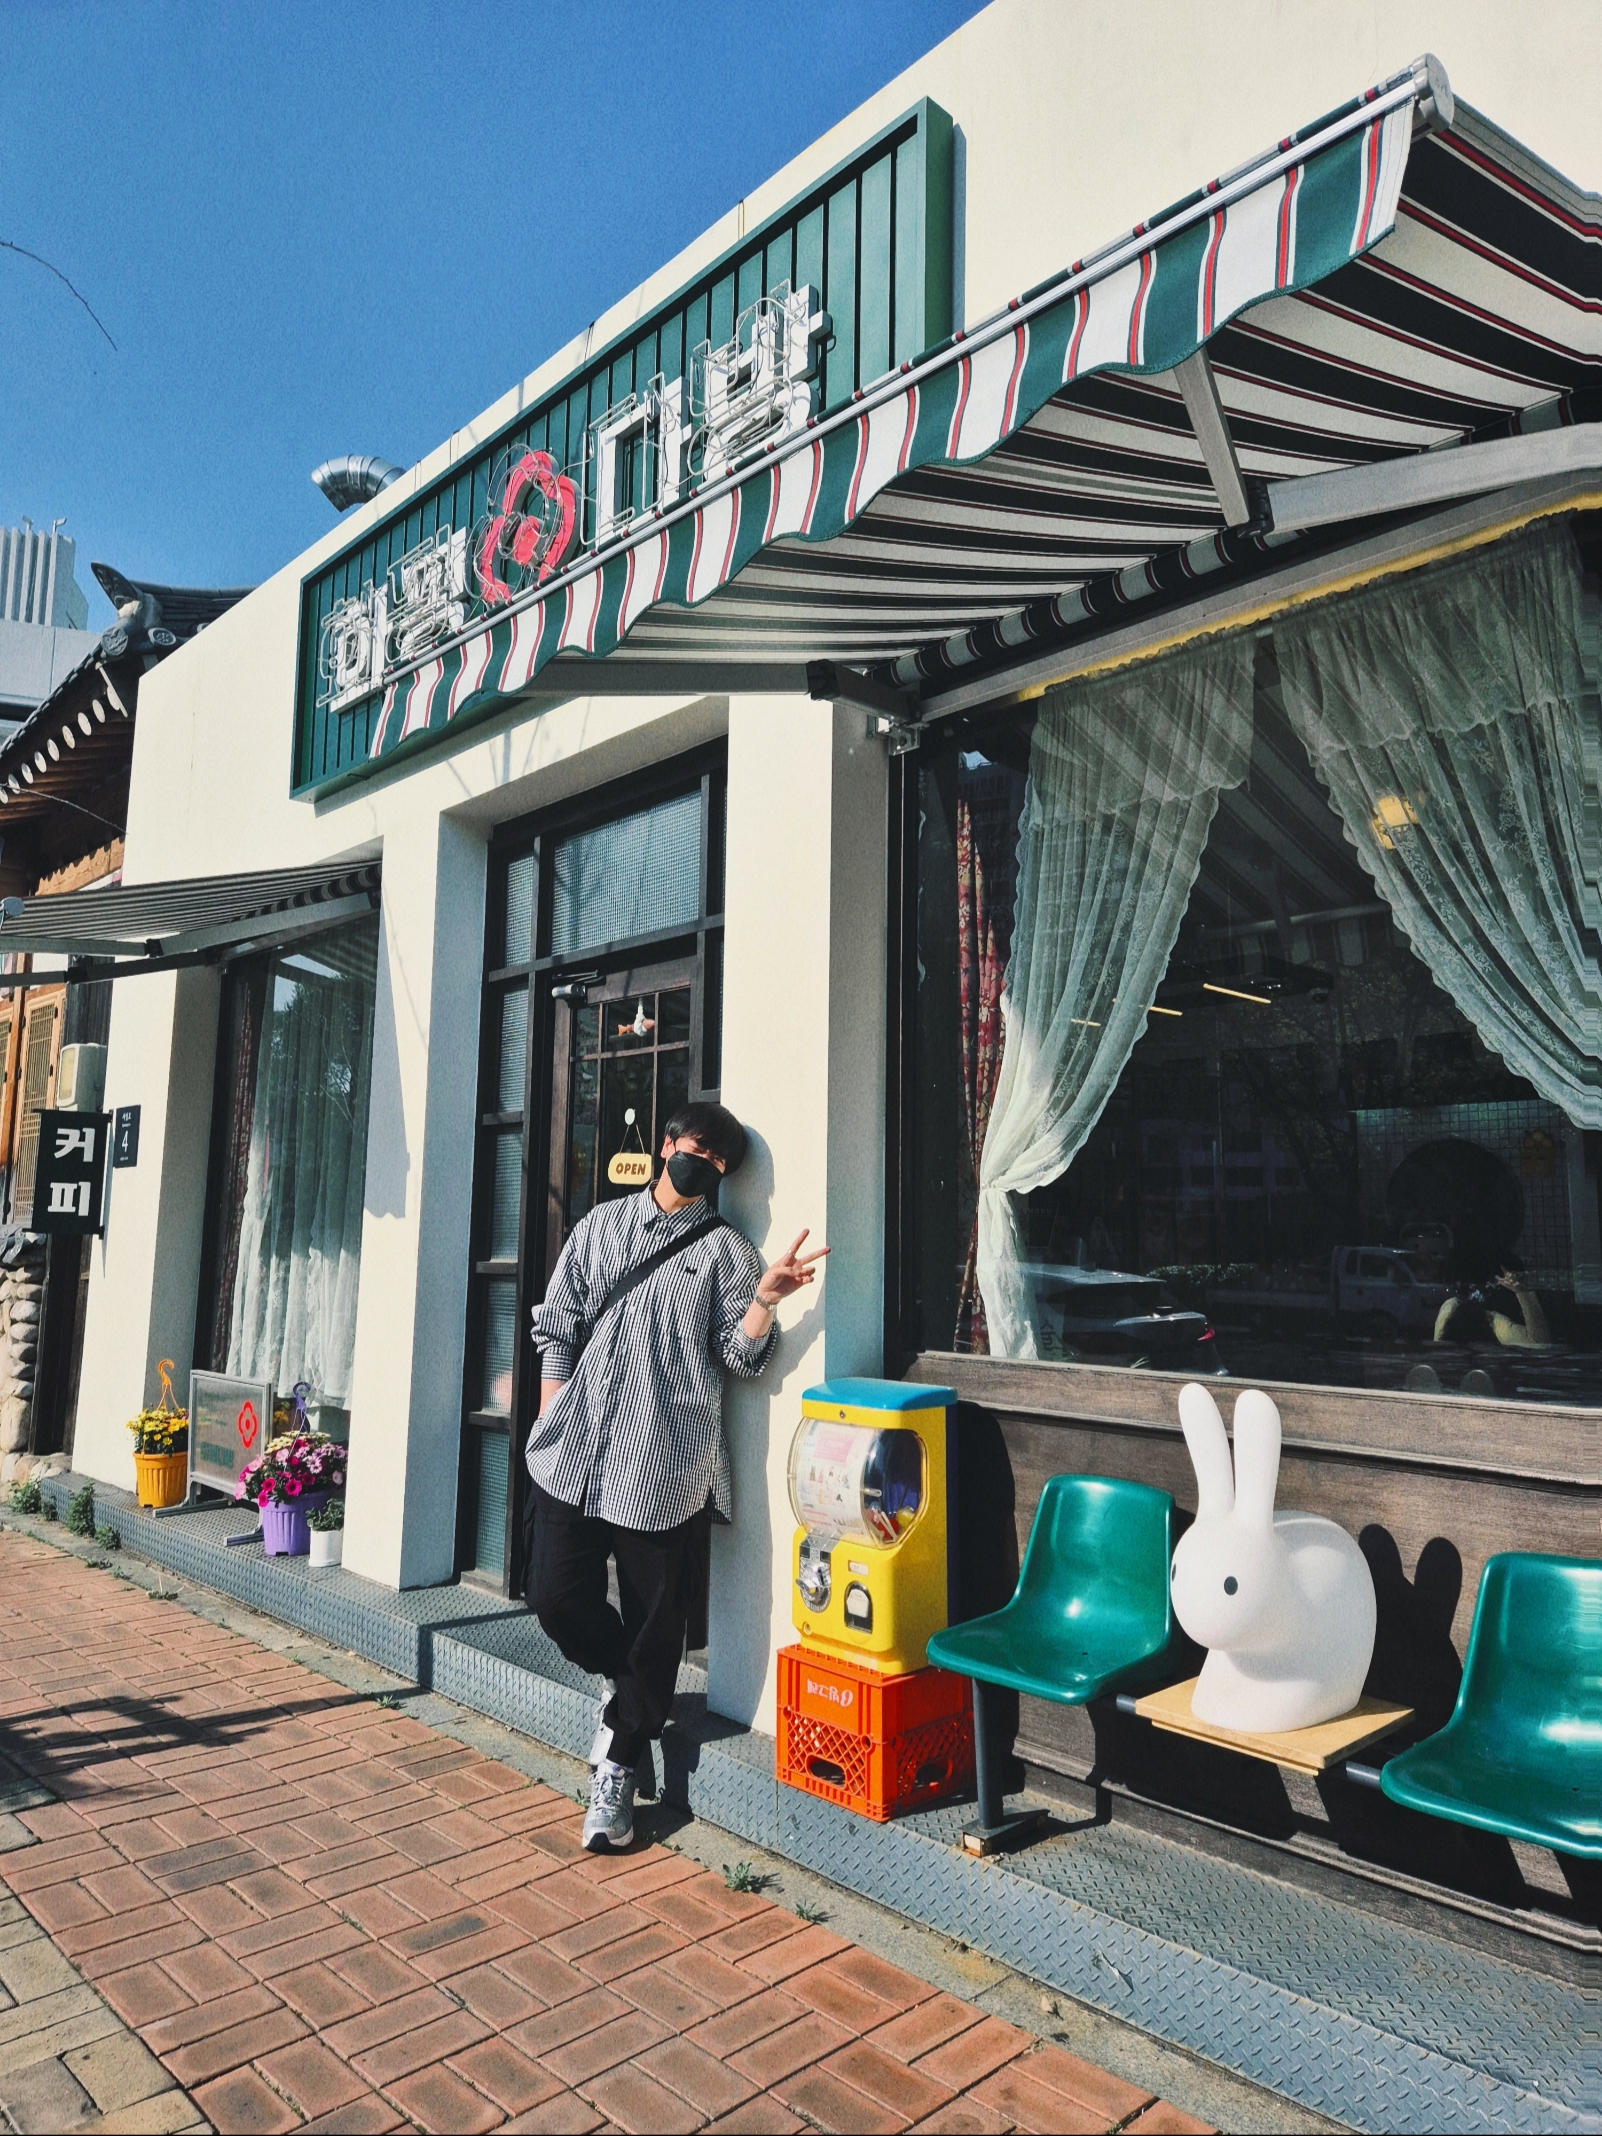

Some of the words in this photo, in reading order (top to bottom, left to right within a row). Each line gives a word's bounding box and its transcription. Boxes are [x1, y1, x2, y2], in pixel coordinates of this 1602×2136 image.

[581, 279, 831, 545] 다방
[122, 1130, 129, 1153] 4
[615, 1162, 647, 1176] OPEN
[48, 1128, 95, 1217] 커피
